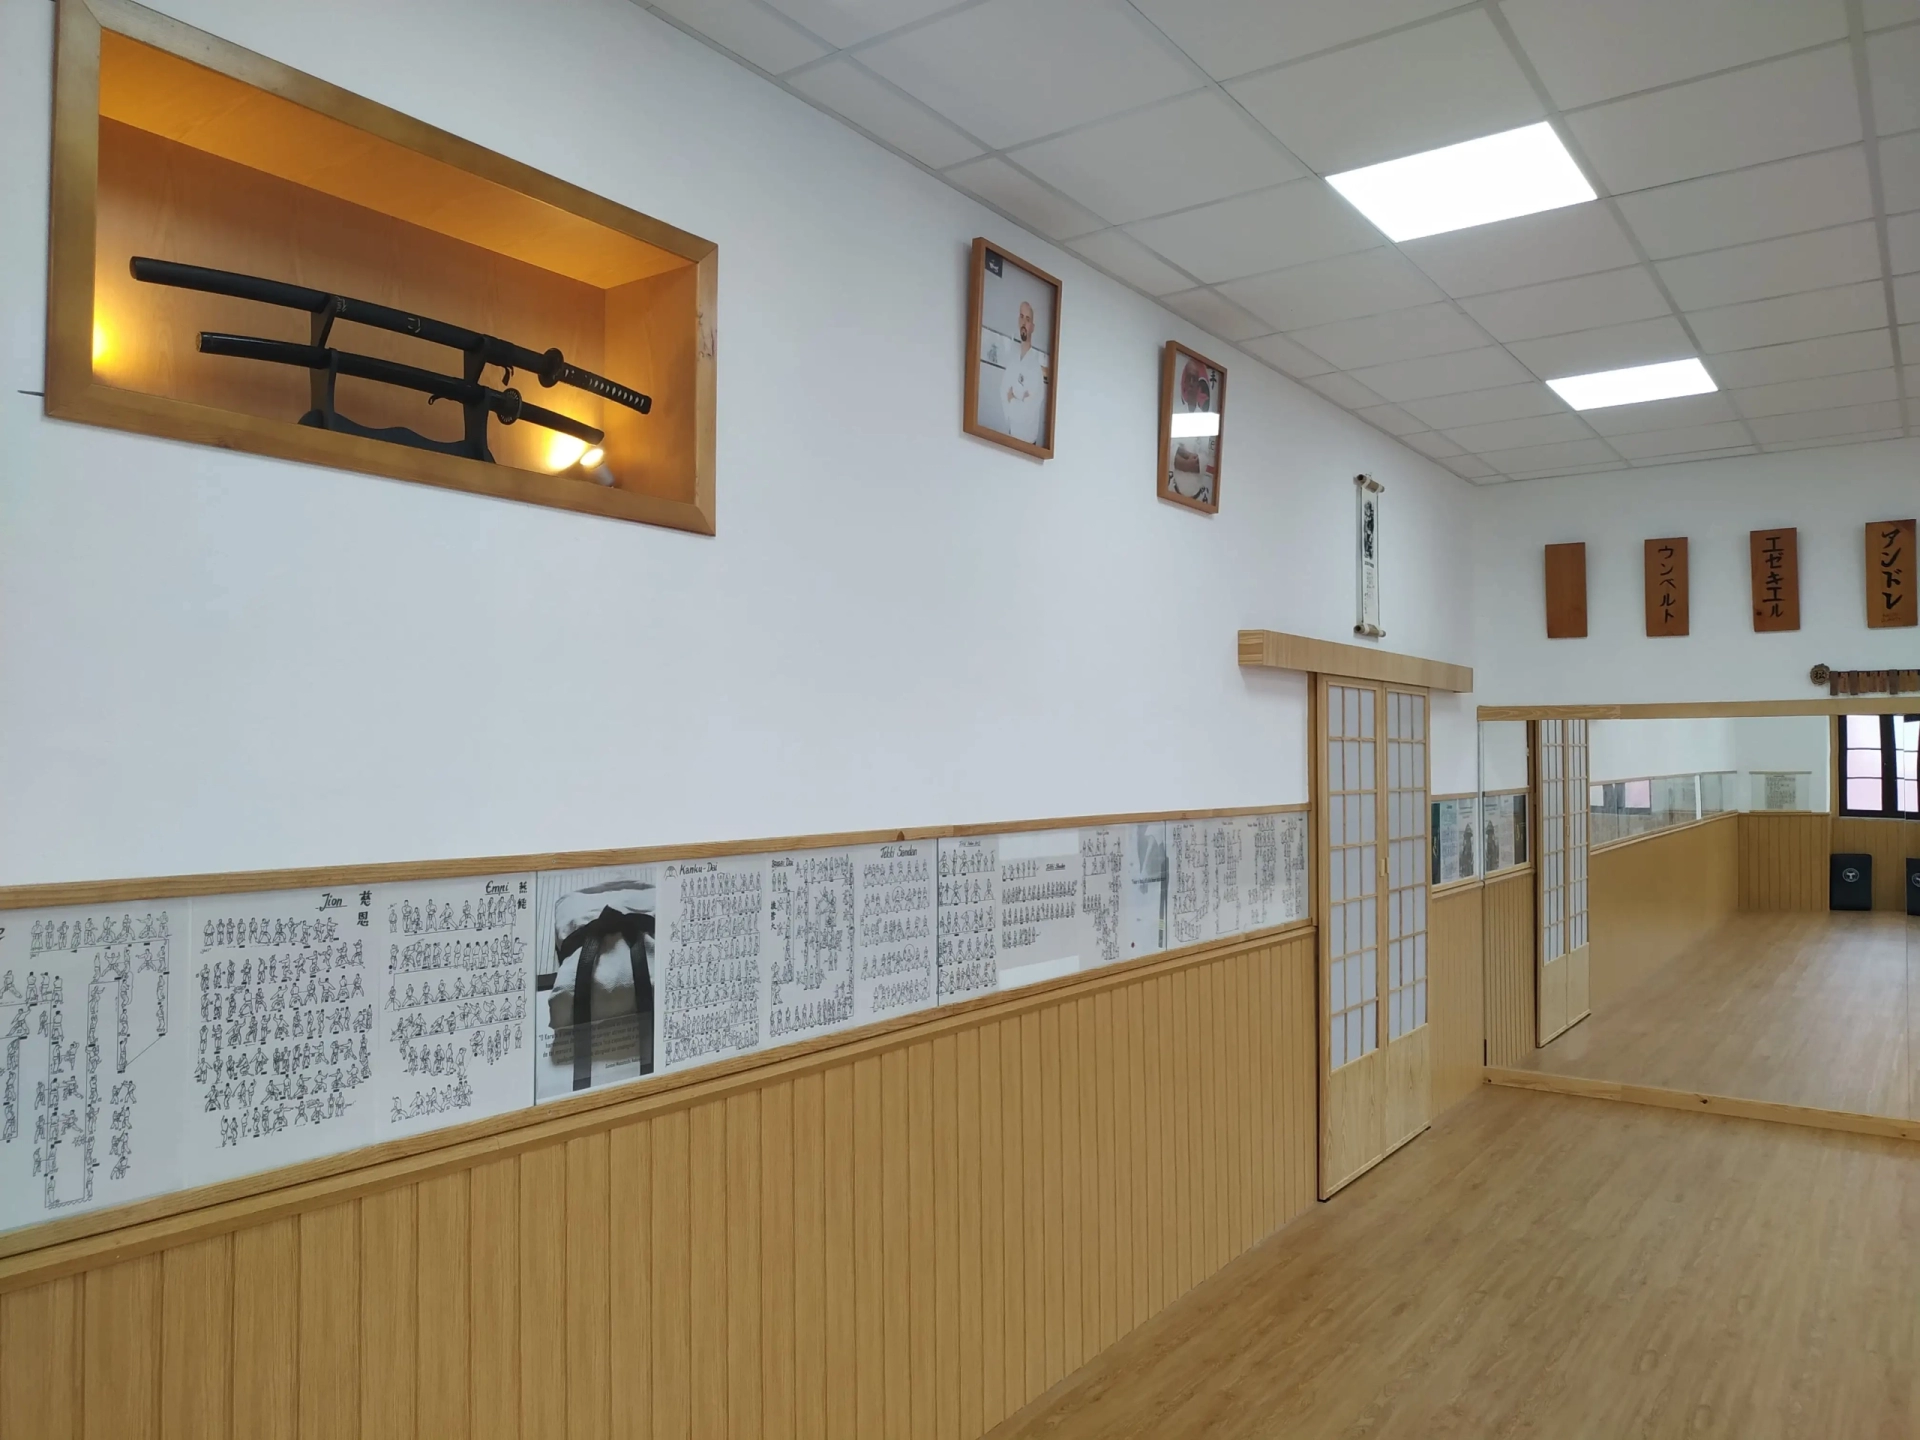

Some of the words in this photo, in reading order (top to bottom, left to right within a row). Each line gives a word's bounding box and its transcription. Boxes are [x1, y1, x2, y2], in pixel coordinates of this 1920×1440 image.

[1658, 545, 1676, 623] ウンベルト
[1762, 537, 1785, 618] エゼキエル
[1881, 528, 1902, 609] アンドレ
[319, 893, 343, 911] Jion
